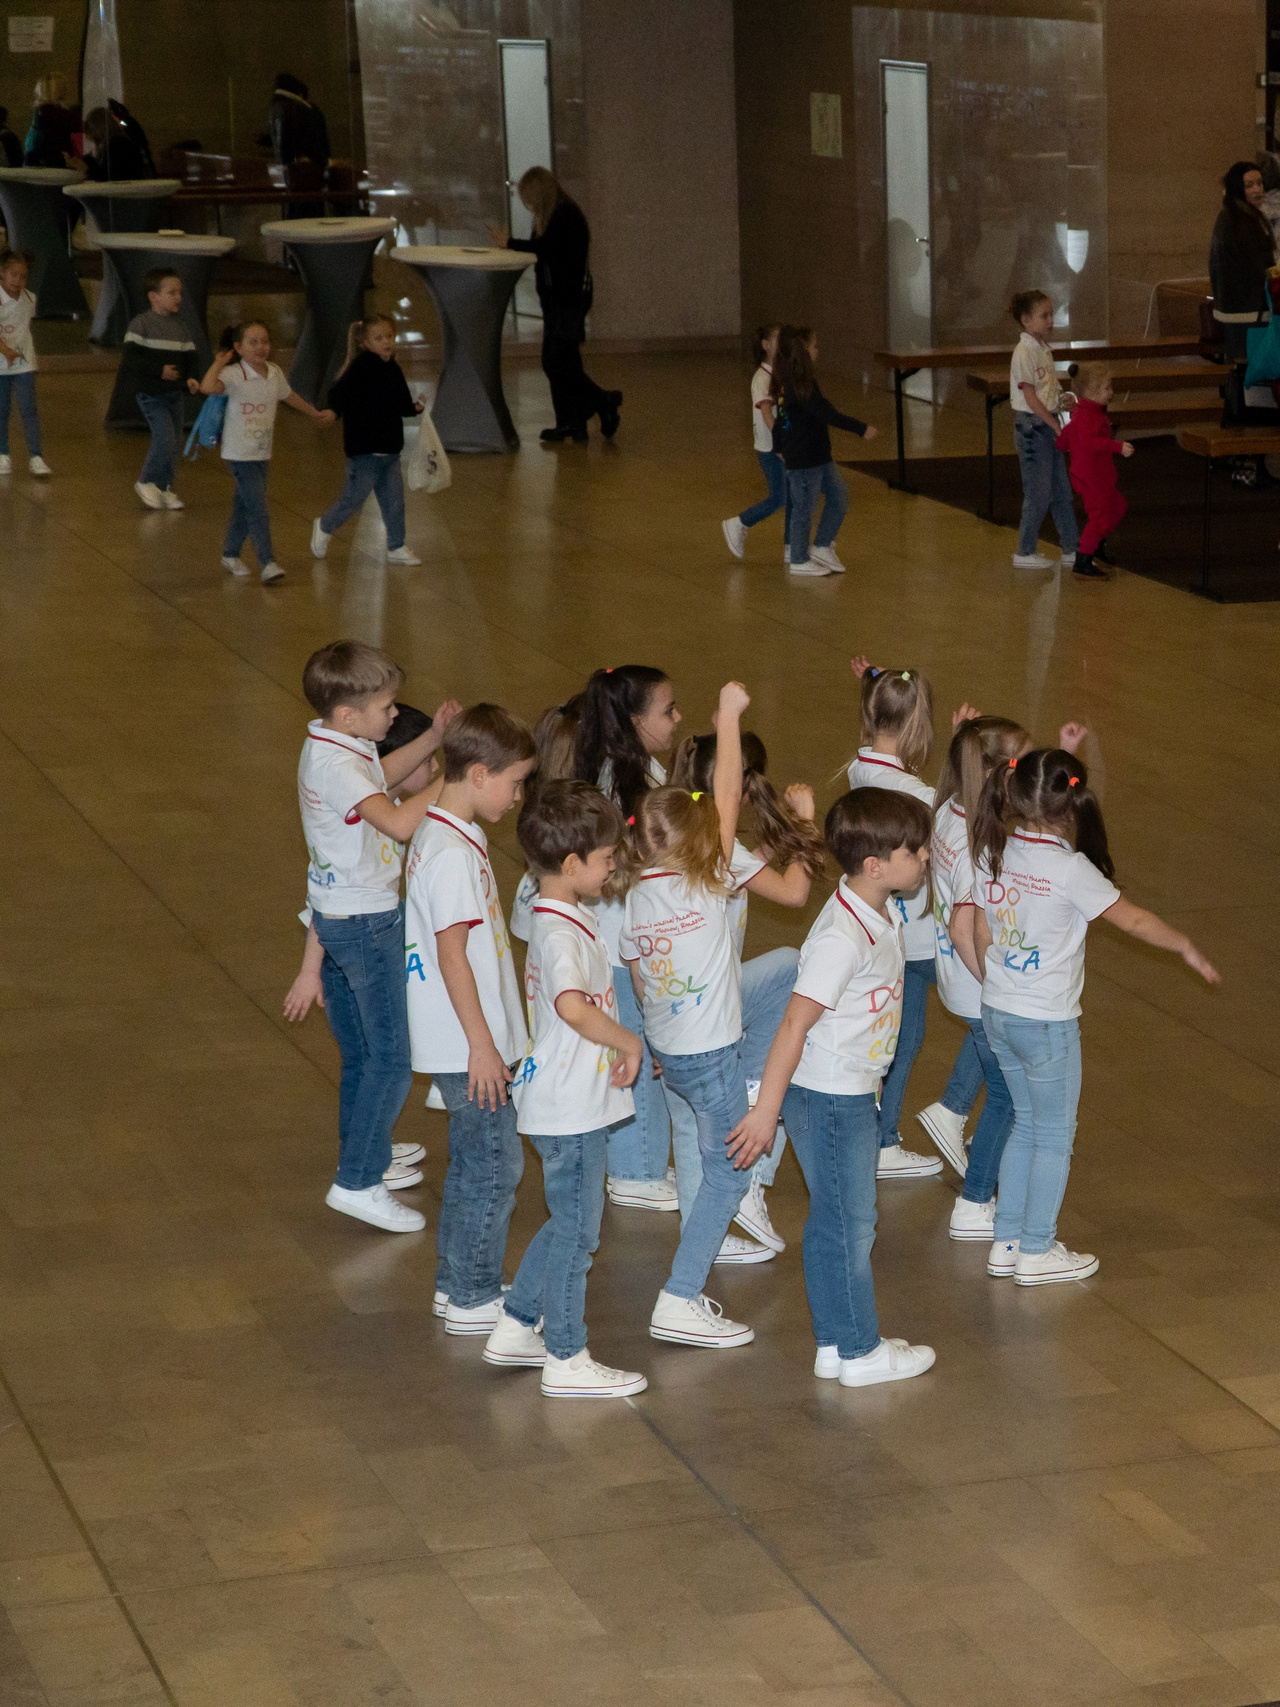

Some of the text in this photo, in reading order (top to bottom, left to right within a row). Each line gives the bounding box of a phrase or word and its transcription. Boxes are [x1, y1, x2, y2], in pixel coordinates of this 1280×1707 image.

[985, 881, 1020, 906] DO
[996, 907, 1017, 928] MI
[638, 935, 672, 957] DO
[1004, 950, 1040, 972] KA
